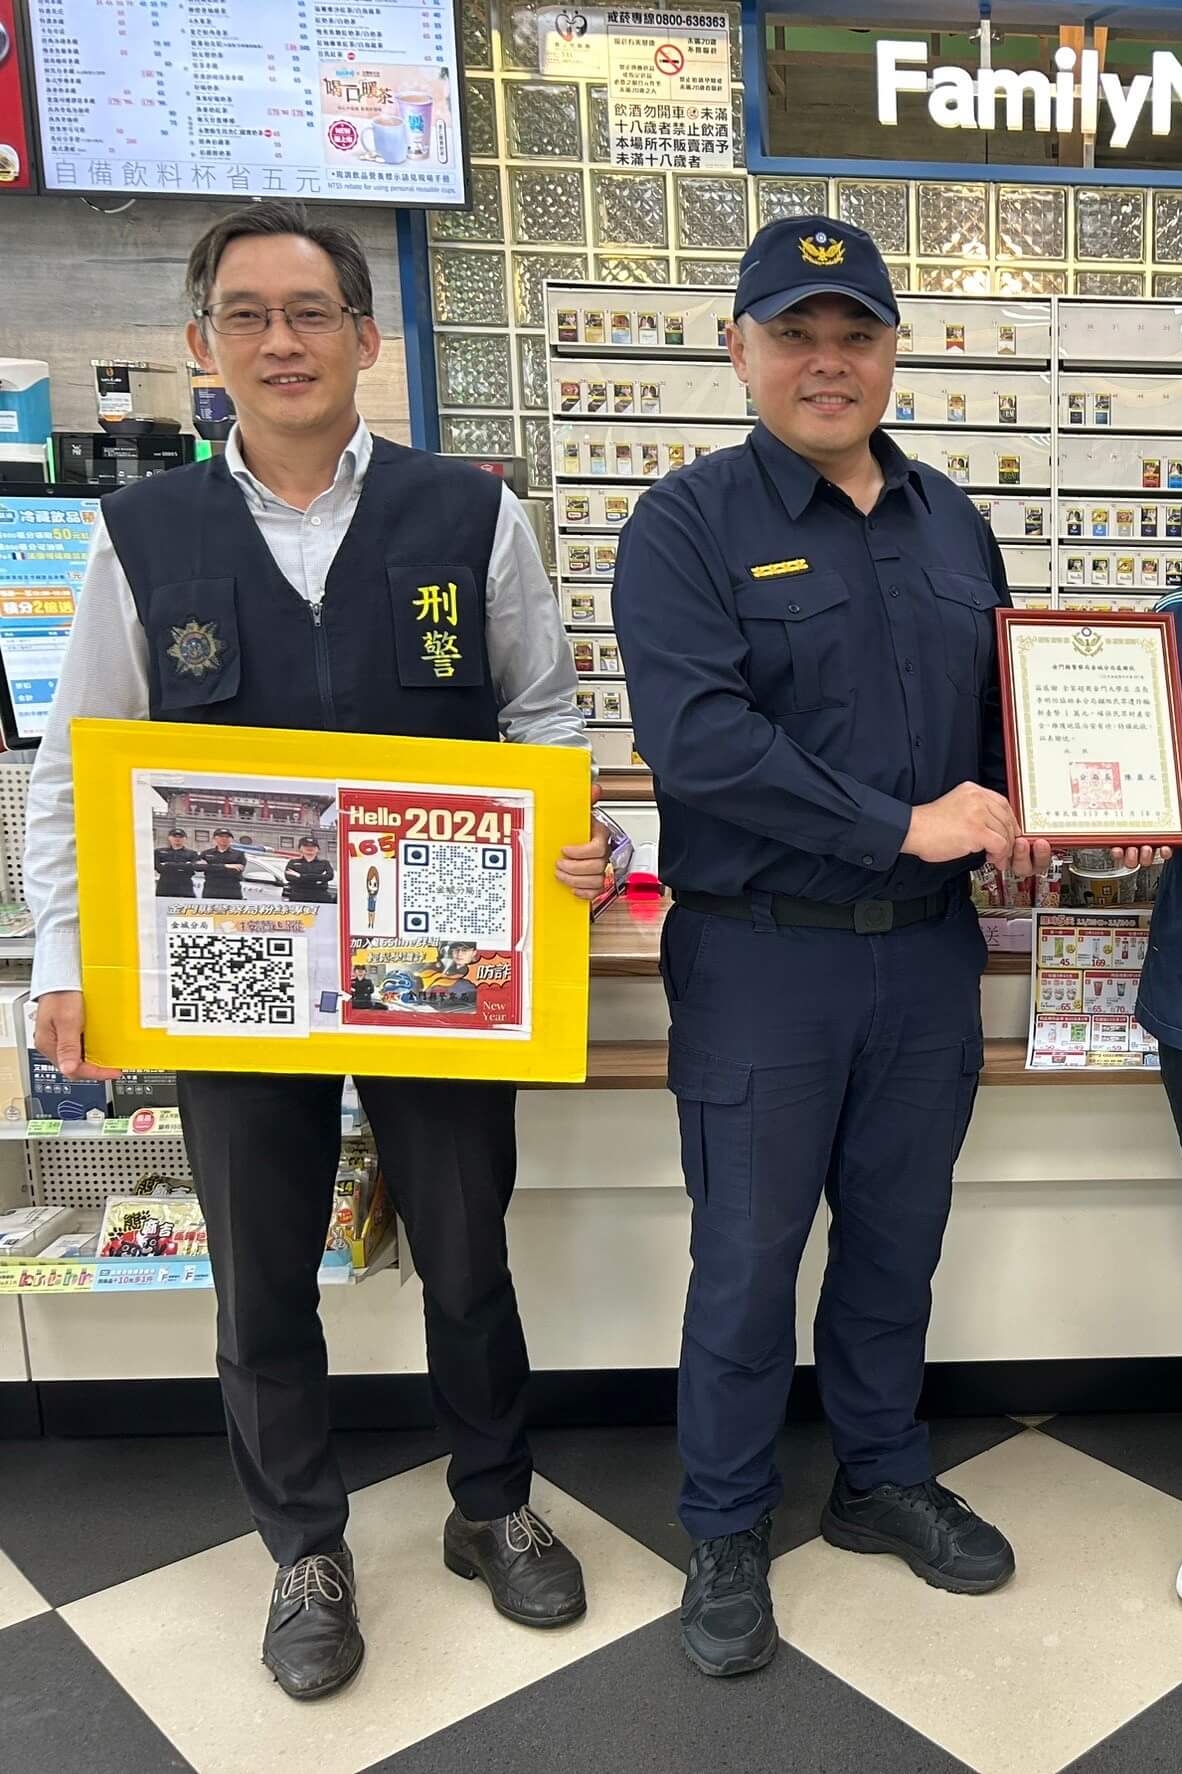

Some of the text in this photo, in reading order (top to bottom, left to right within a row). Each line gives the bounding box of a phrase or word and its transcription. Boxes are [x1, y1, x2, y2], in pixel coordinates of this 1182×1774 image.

[607, 11, 726, 28] 戒菸專線0800-636363
[614, 104, 728, 122] 飲酒勿開車 未滿
[615, 119, 729, 138] 十八歲者禁止飲酒
[615, 136, 729, 154] 本場所不販賣酒予
[616, 152, 701, 169] 未滿十八歲者
[55, 160, 322, 193] 自備飲料杯省五元
[412, 582, 463, 678] 刑警
[350, 806, 512, 843] Hello 2024!
[170, 920, 209, 930] 金城分局
[483, 1001, 505, 1010] New
[482, 1012, 506, 1021] Year
